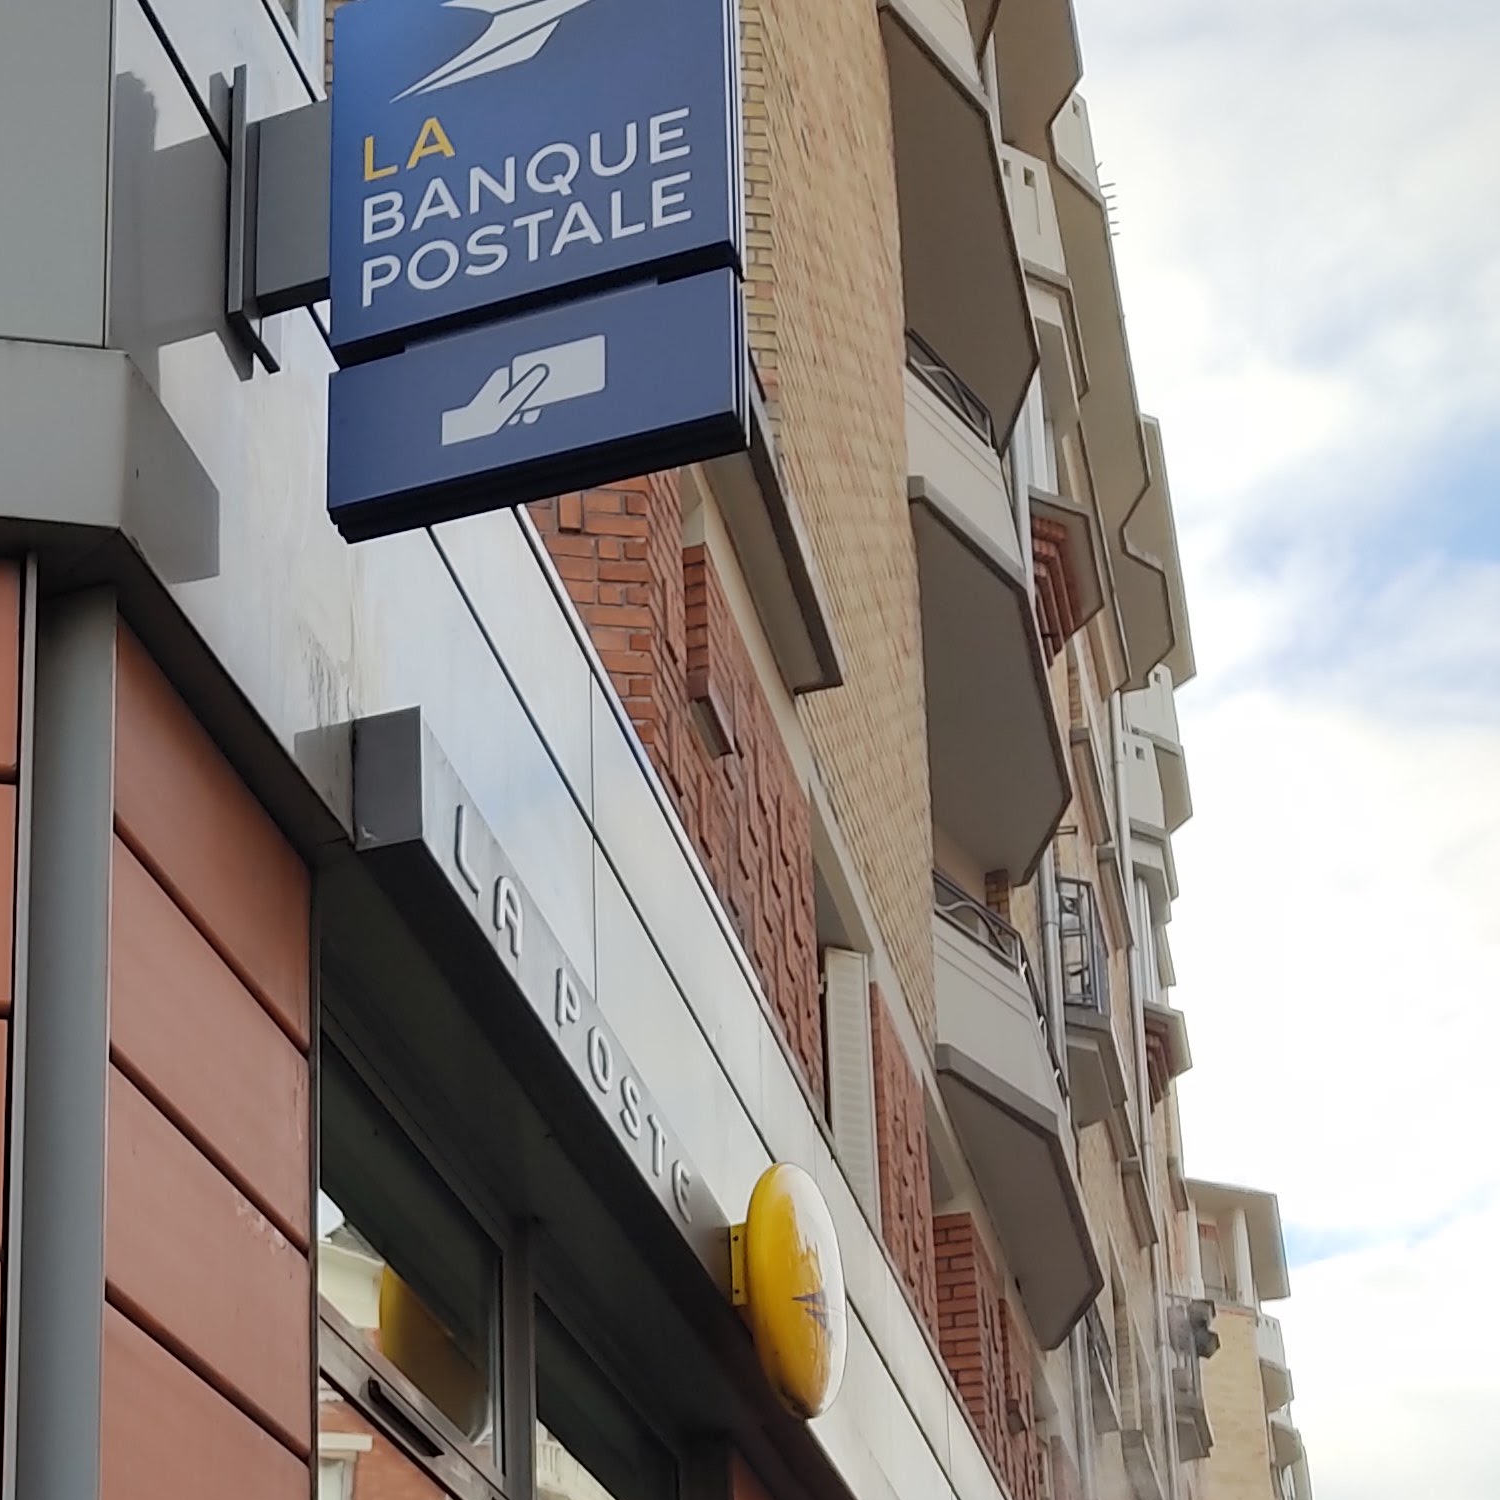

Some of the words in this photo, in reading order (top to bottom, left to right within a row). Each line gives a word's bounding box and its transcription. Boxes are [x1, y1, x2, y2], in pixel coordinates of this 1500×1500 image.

[363, 116, 456, 182] LA
[363, 105, 691, 246] BANQUE
[361, 170, 693, 308] POSTALE
[454, 803, 525, 958] LA
[555, 965, 693, 1224] POSTE
